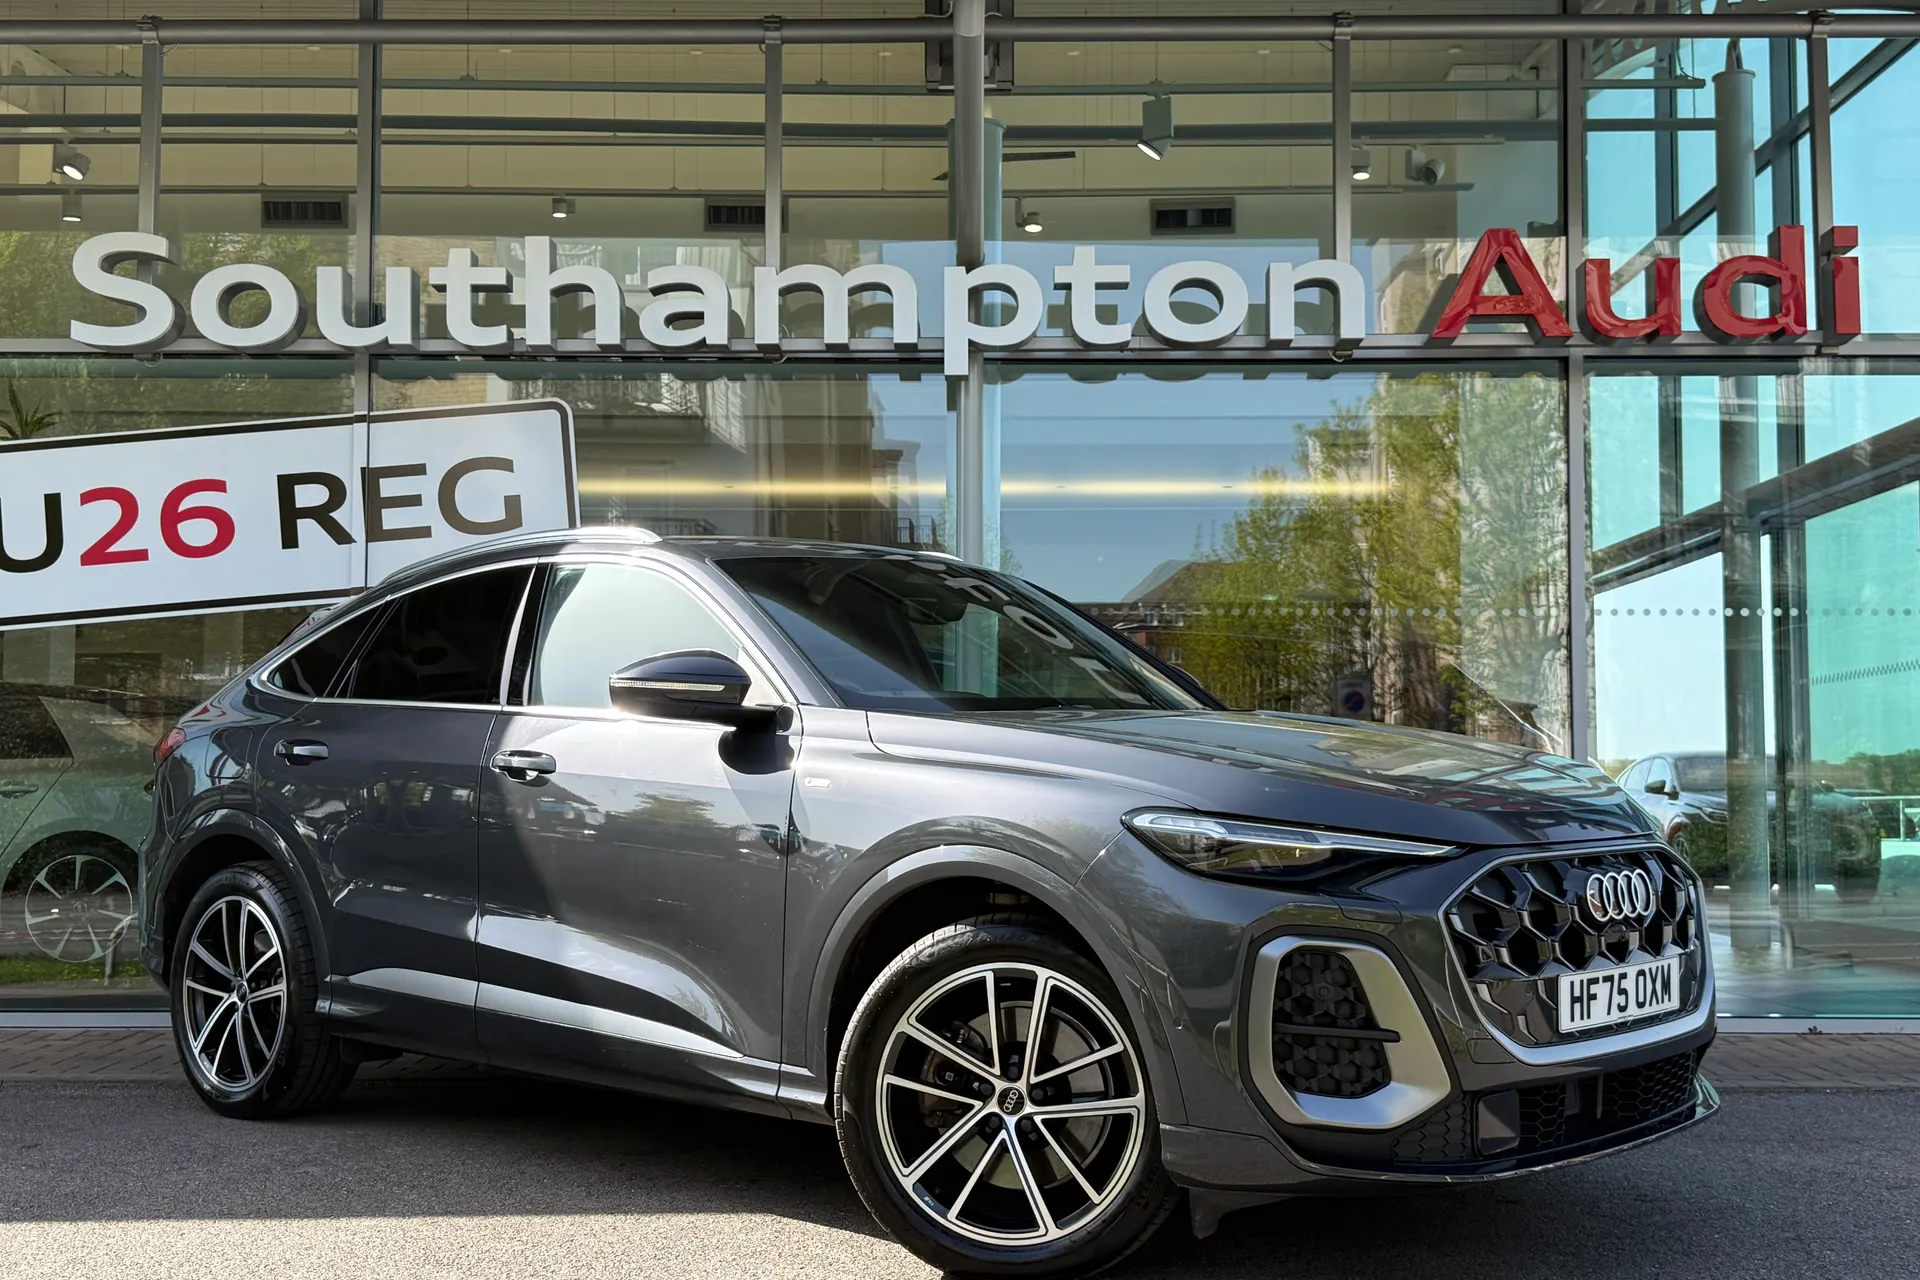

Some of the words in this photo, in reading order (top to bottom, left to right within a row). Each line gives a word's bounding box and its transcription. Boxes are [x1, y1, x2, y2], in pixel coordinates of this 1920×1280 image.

[70, 232, 1366, 377] Southampton
[1427, 224, 1861, 343] Audi
[275, 456, 524, 550] REG
[1569, 971, 1629, 1023] HF75
[1635, 962, 1672, 1009] OXM
